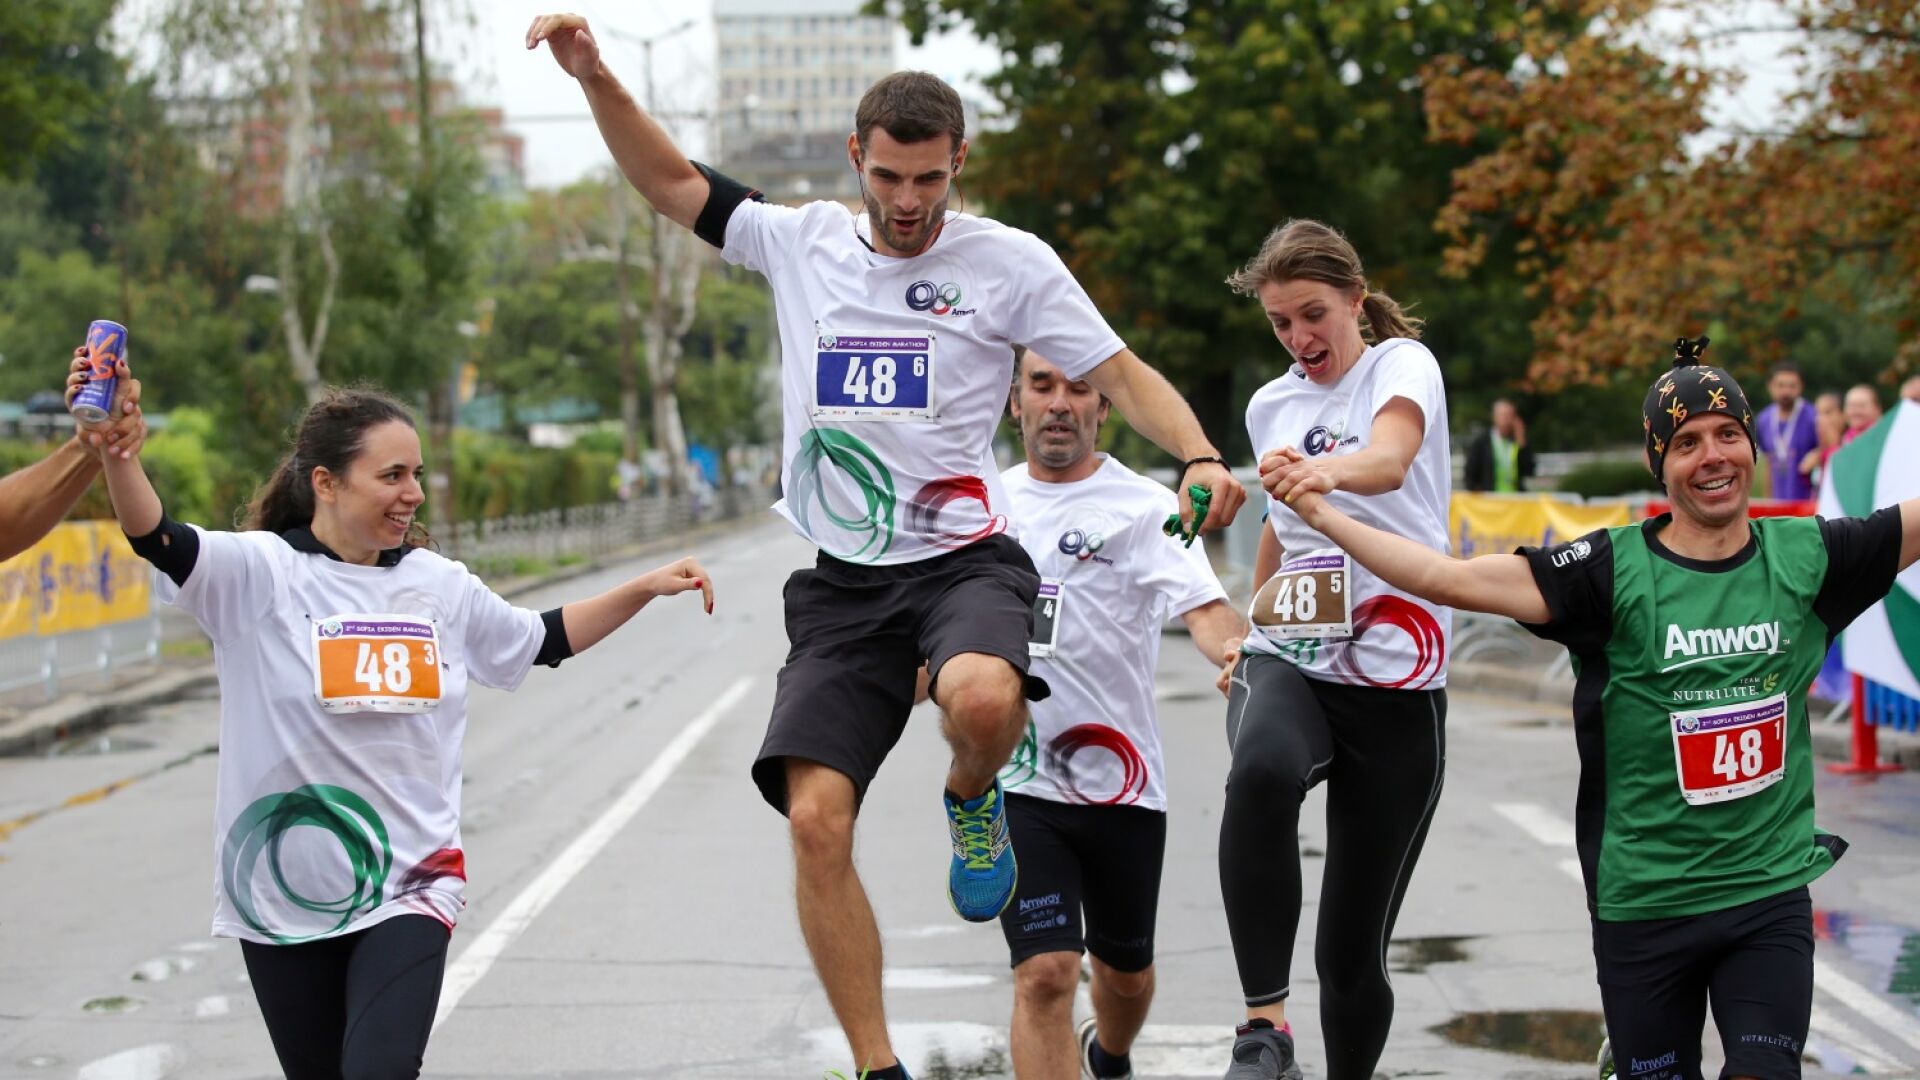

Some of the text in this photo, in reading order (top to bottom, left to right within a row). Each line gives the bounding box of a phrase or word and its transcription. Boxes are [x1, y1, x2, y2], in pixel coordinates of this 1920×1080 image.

[913, 356, 925, 377] 6
[843, 356, 897, 404] 48
[1330, 572, 1342, 593] 5
[1043, 599, 1053, 618] 4
[1273, 575, 1317, 622] 48
[402, 626, 431, 635] MARATHON
[1663, 621, 1779, 660] Amway
[423, 643, 435, 666] 3
[355, 642, 412, 694] 48
[1672, 685, 1756, 701] NUTRILITE
[1756, 705, 1782, 718] MARATHON
[1774, 720, 1781, 741] 1
[1712, 728, 1763, 781] 48
[1019, 893, 1060, 911] Amway
[1023, 916, 1055, 931] unicef
[1741, 1034, 1788, 1048] NUTRILITE
[1631, 1050, 1675, 1071] Amway
